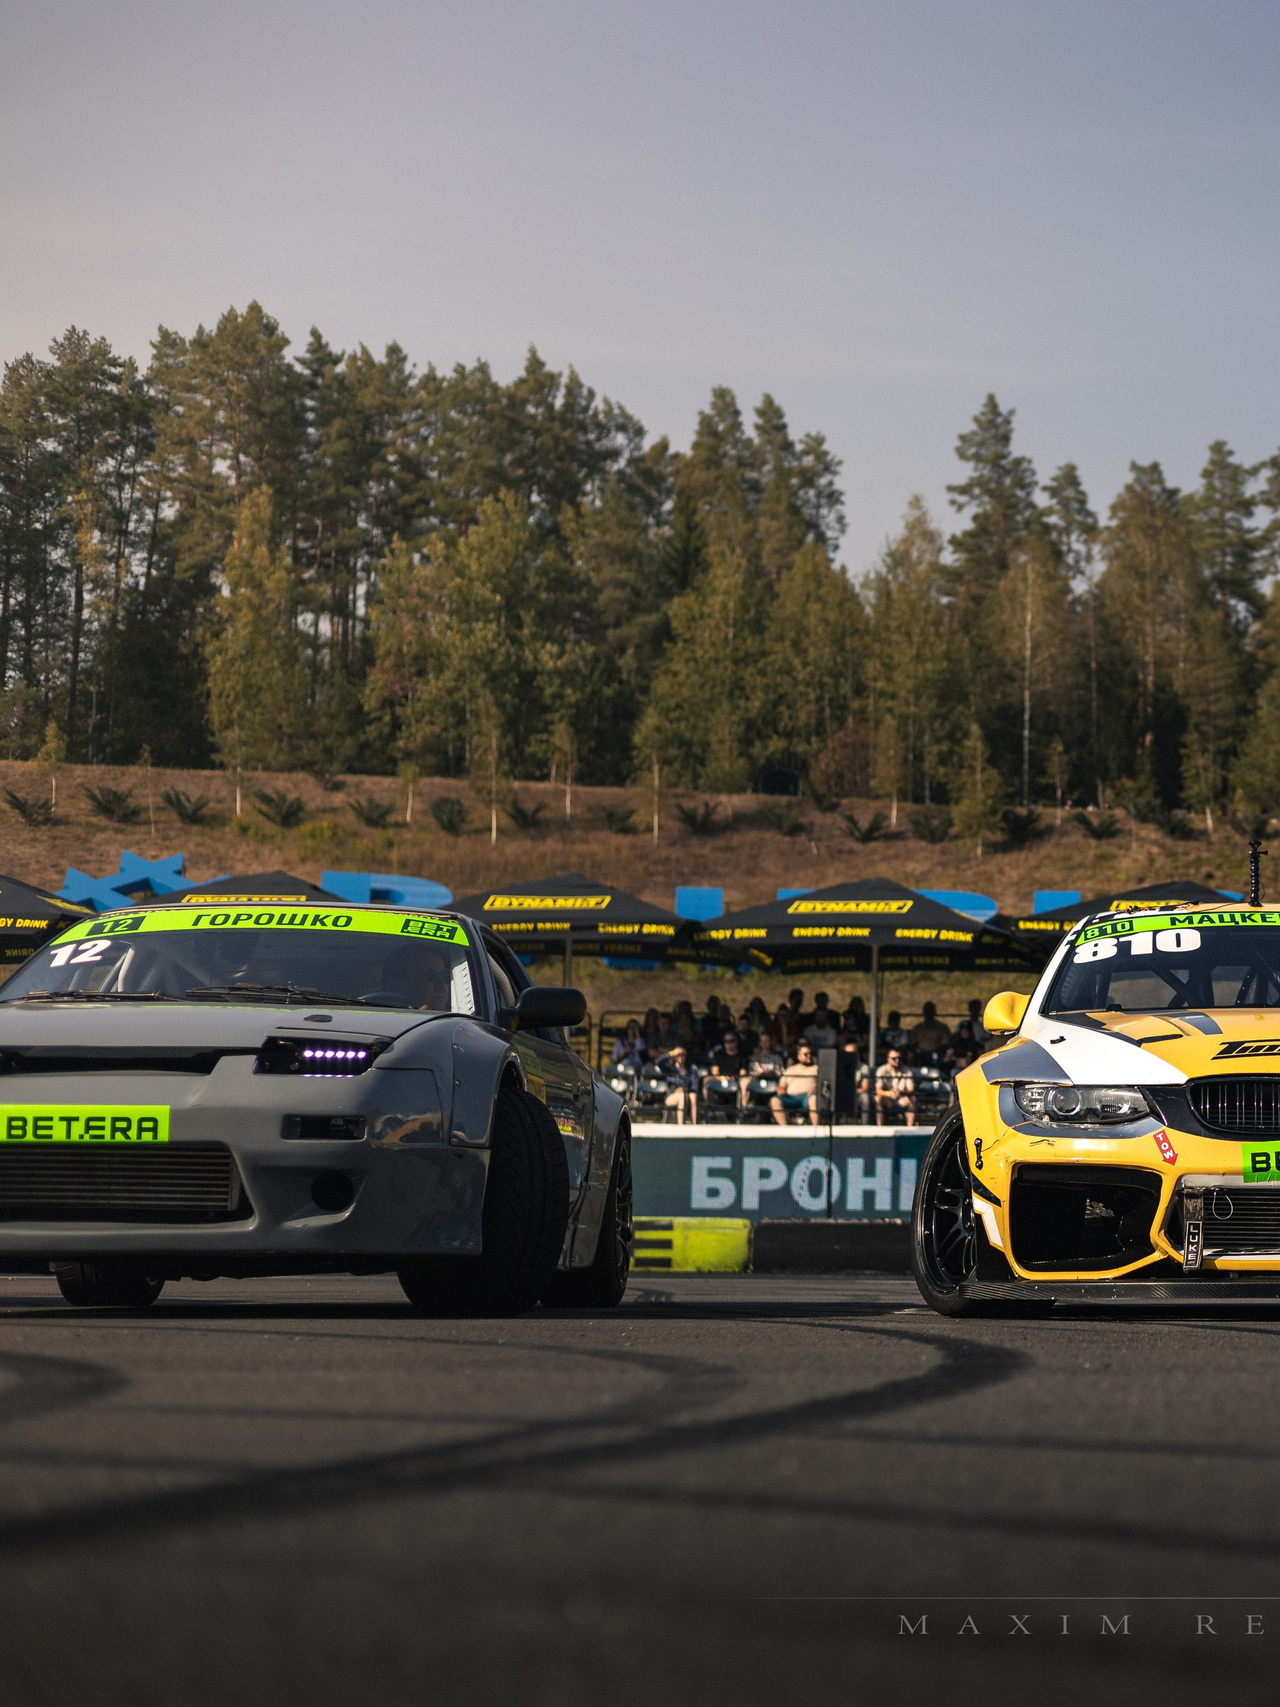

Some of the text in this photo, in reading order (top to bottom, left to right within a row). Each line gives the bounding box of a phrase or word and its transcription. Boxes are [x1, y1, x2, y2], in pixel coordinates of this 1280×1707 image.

[15, 918, 49, 929] DRINK
[102, 918, 134, 934] 12
[192, 912, 353, 928] ГОРОШКО
[492, 922, 571, 932] ENERGY DRINK
[1018, 919, 1061, 931] ENERGY
[597, 922, 675, 936] ENERGY DRINK
[733, 928, 768, 939] DRINK
[792, 926, 871, 938] ENERGY DRINK
[895, 927, 974, 942] ENERGY DRINK
[1085, 920, 1132, 940] 810
[49, 939, 112, 968] 12
[1073, 928, 1201, 964] 810
[1156, 1132, 1174, 1160] TOW
[1187, 1224, 1199, 1261] LUKE
